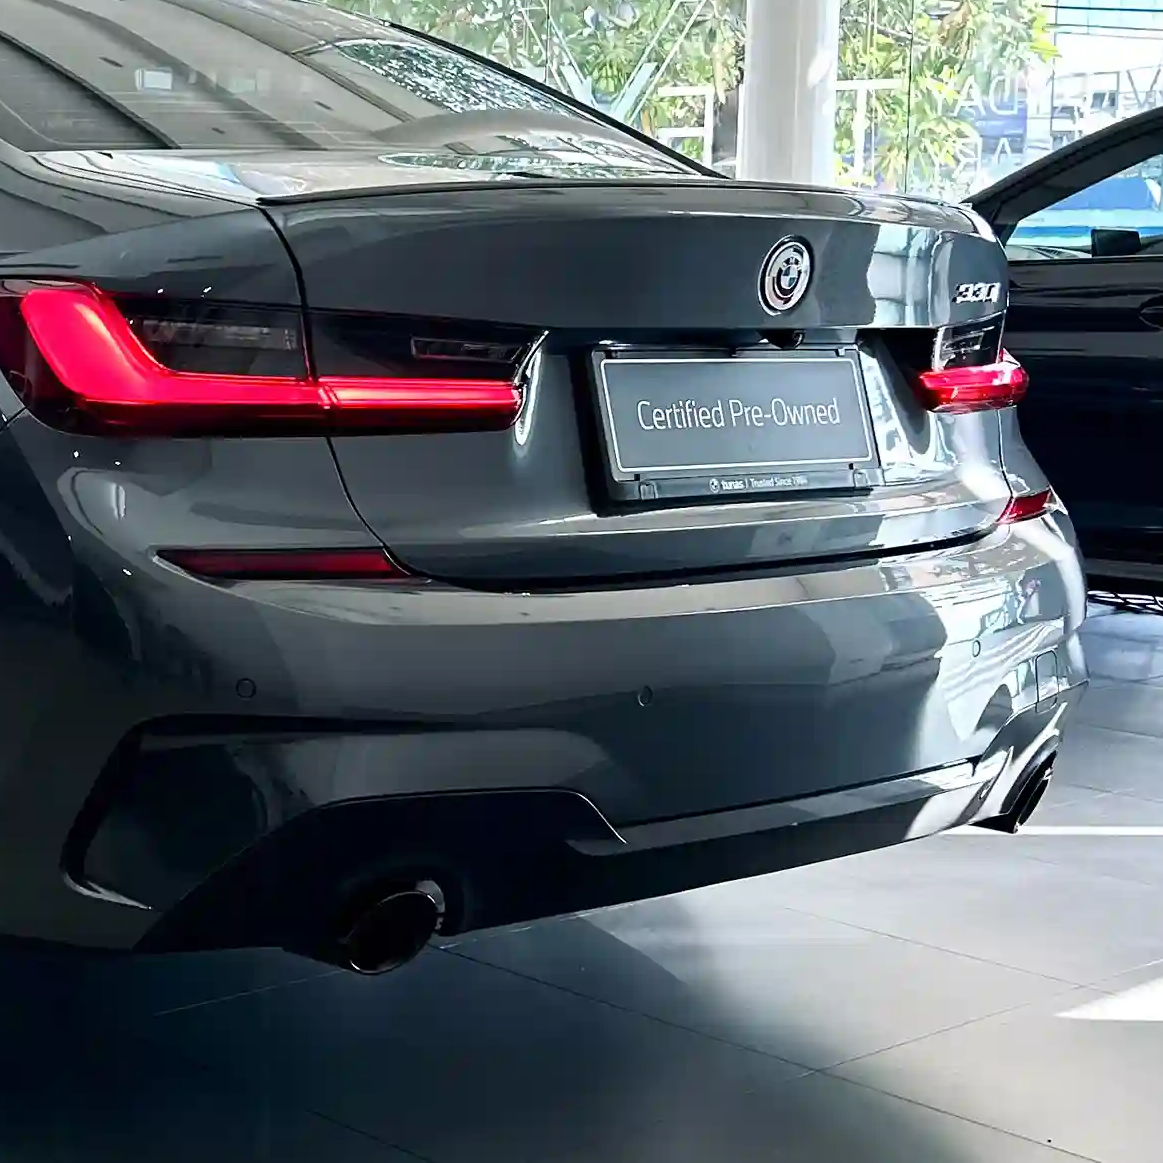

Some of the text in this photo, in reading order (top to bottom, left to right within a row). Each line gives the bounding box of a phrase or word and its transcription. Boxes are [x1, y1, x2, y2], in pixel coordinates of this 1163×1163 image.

[638, 397, 841, 430] Certified Pre-Owned
[721, 479, 744, 490] tunas
